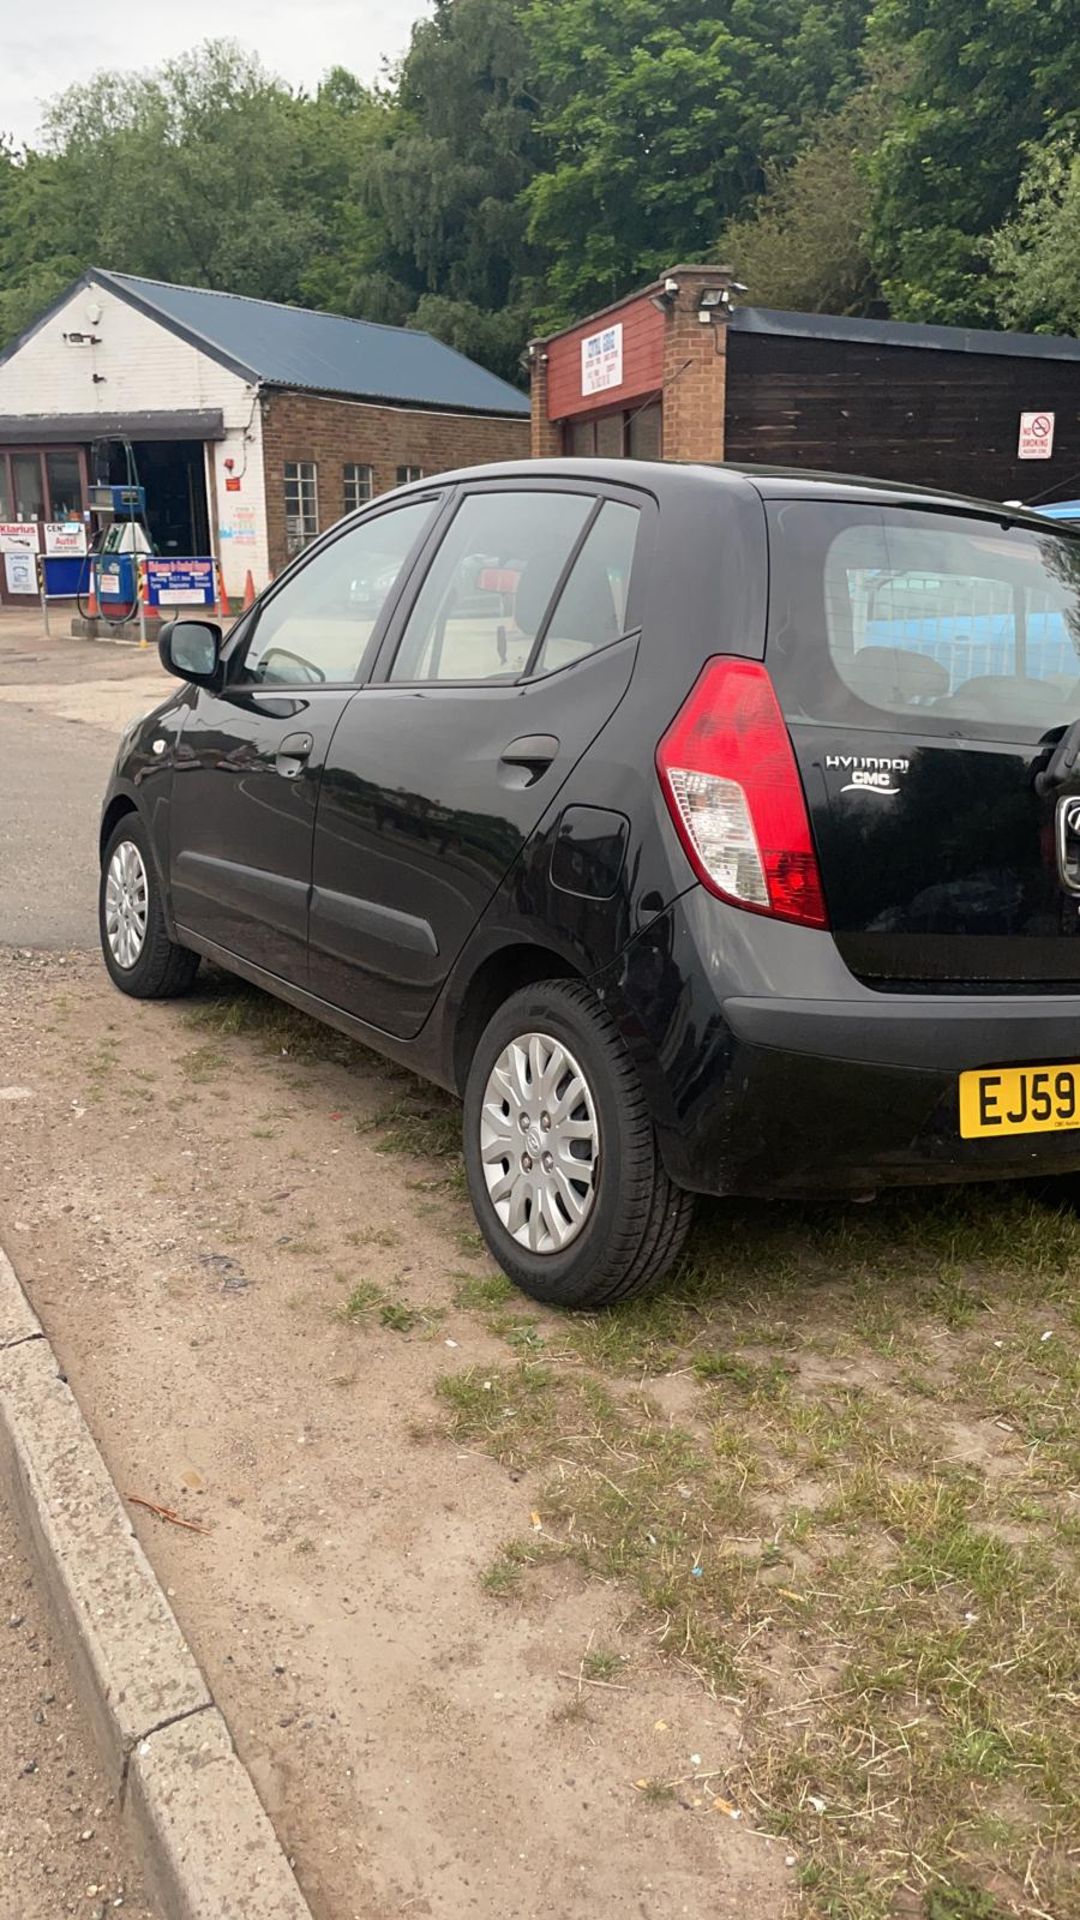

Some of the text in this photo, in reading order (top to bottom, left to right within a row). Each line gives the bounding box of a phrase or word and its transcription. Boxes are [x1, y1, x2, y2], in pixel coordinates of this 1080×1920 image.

[1023, 428, 1031, 436] NO
[1022, 439, 1048, 447] SMOKING
[0, 524, 36, 534] Klarius
[826, 755, 909, 771] HYUNDAI
[851, 771, 890, 786] CMC
[979, 1072, 1076, 1126] EJ59
